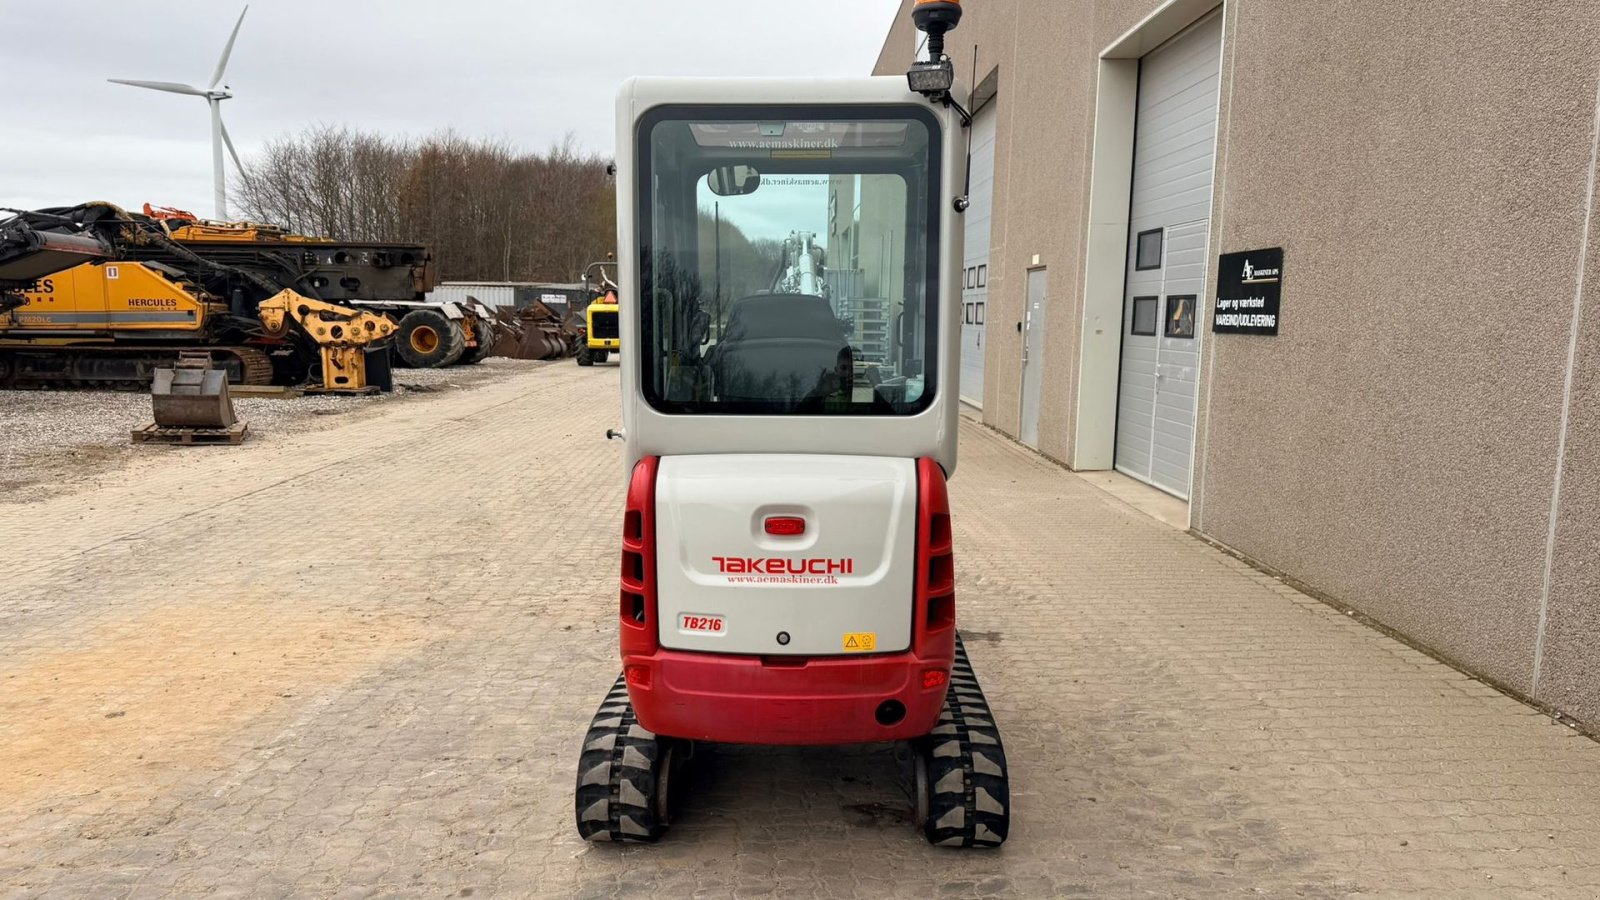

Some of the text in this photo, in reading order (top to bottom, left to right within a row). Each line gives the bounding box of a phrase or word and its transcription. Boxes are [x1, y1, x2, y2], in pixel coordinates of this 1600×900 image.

[729, 138, 839, 149] www.aemaskiner.dk
[128, 299, 177, 307] HERCULES
[1217, 296, 1265, 310] Lager og værksted
[712, 557, 852, 574] TAKEUCHI
[728, 575, 838, 585] www.aemaskiner.dk
[683, 616, 722, 631] TB216
